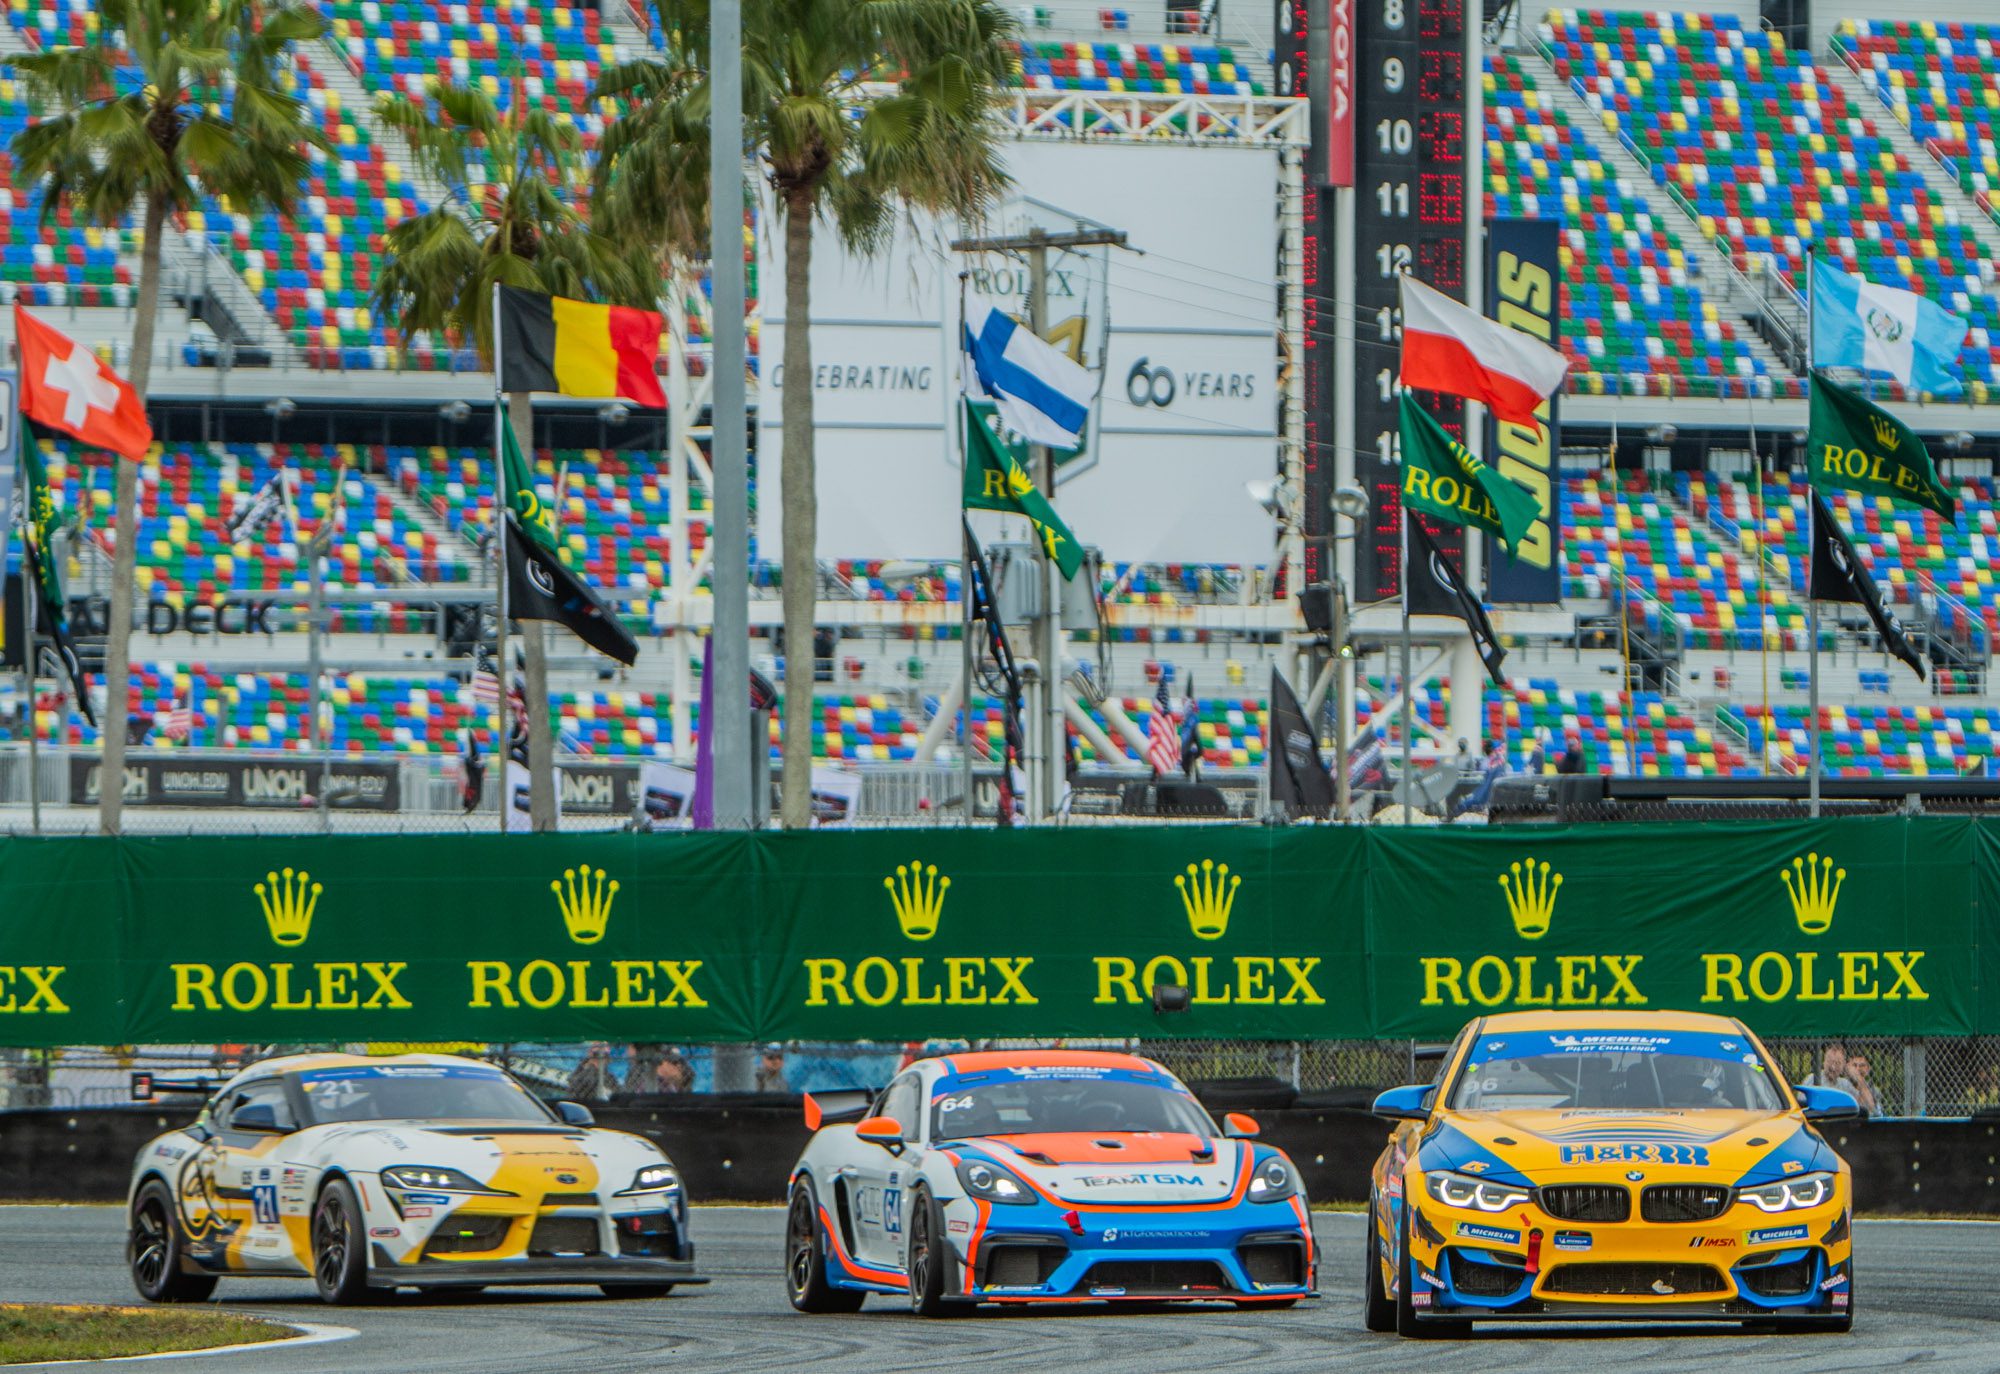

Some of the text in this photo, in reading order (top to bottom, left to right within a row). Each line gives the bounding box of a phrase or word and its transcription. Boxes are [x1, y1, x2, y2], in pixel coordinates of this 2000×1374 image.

[1383, 0, 1406, 31] 8
[1383, 57, 1406, 94] 9
[1376, 118, 1413, 155] 10
[1376, 181, 1410, 217] 11
[1376, 243, 1413, 279] 12
[973, 268, 1075, 297] ROLX
[771, 364, 932, 391] CEBRATING
[1126, 355, 1256, 408] 60 YEARS
[242, 767, 308, 798] UNOH
[170, 961, 413, 1012] ROLEX
[466, 959, 709, 1010] ROLEX
[803, 956, 1040, 1007] ROLEX
[1092, 955, 1326, 1006] ROLEX
[1420, 954, 1649, 1006] ROLEX
[1700, 951, 1930, 1003] ROLEX
[1582, 1035, 1671, 1045] MICHELIN
[320, 1079, 355, 1096] 21
[940, 1095, 975, 1113] 64
[1470, 1227, 1515, 1240] MICHELIN
[1704, 1238, 1737, 1247] IMSA
[1761, 1228, 1804, 1240] MICHELIN
